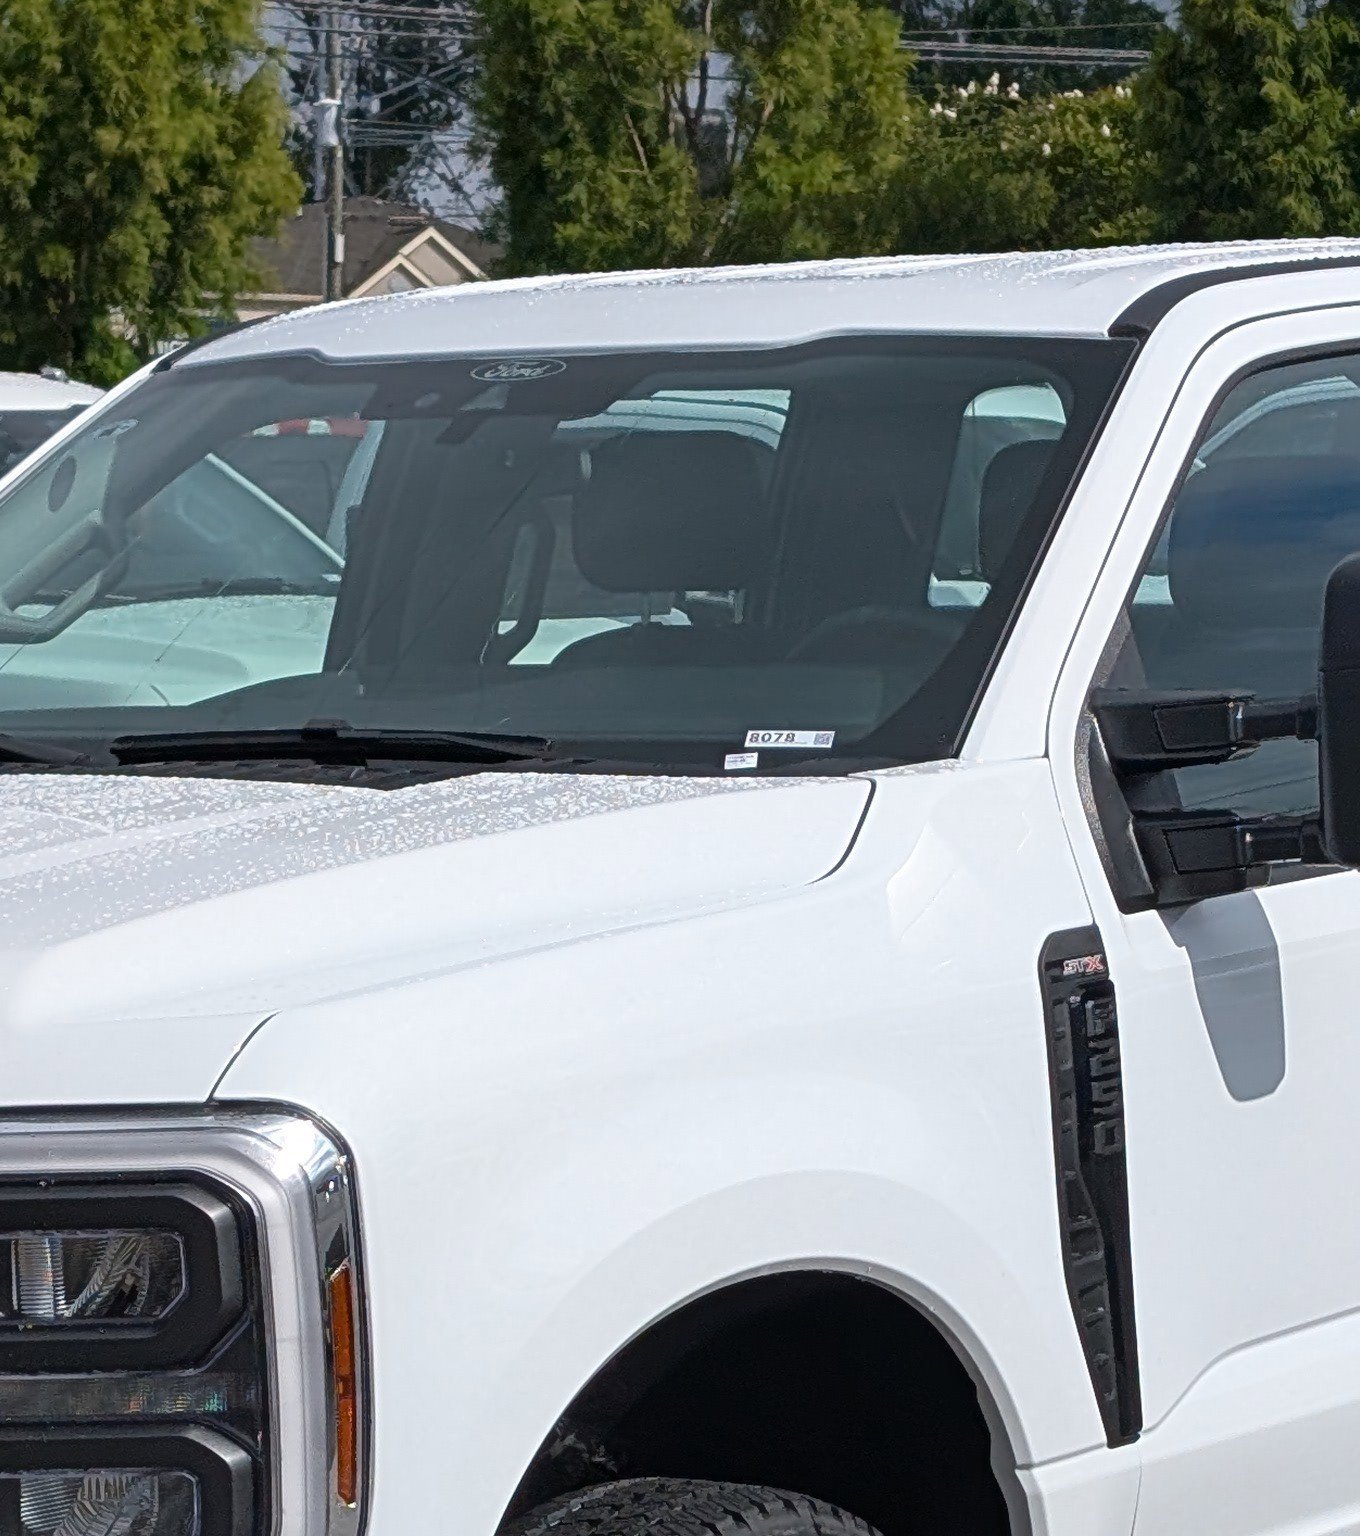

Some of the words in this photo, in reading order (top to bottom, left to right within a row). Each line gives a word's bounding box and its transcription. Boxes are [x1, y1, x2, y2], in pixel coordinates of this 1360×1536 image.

[484, 360, 552, 378] Ford
[748, 732, 796, 743] 8078
[1062, 953, 1106, 976] STX
